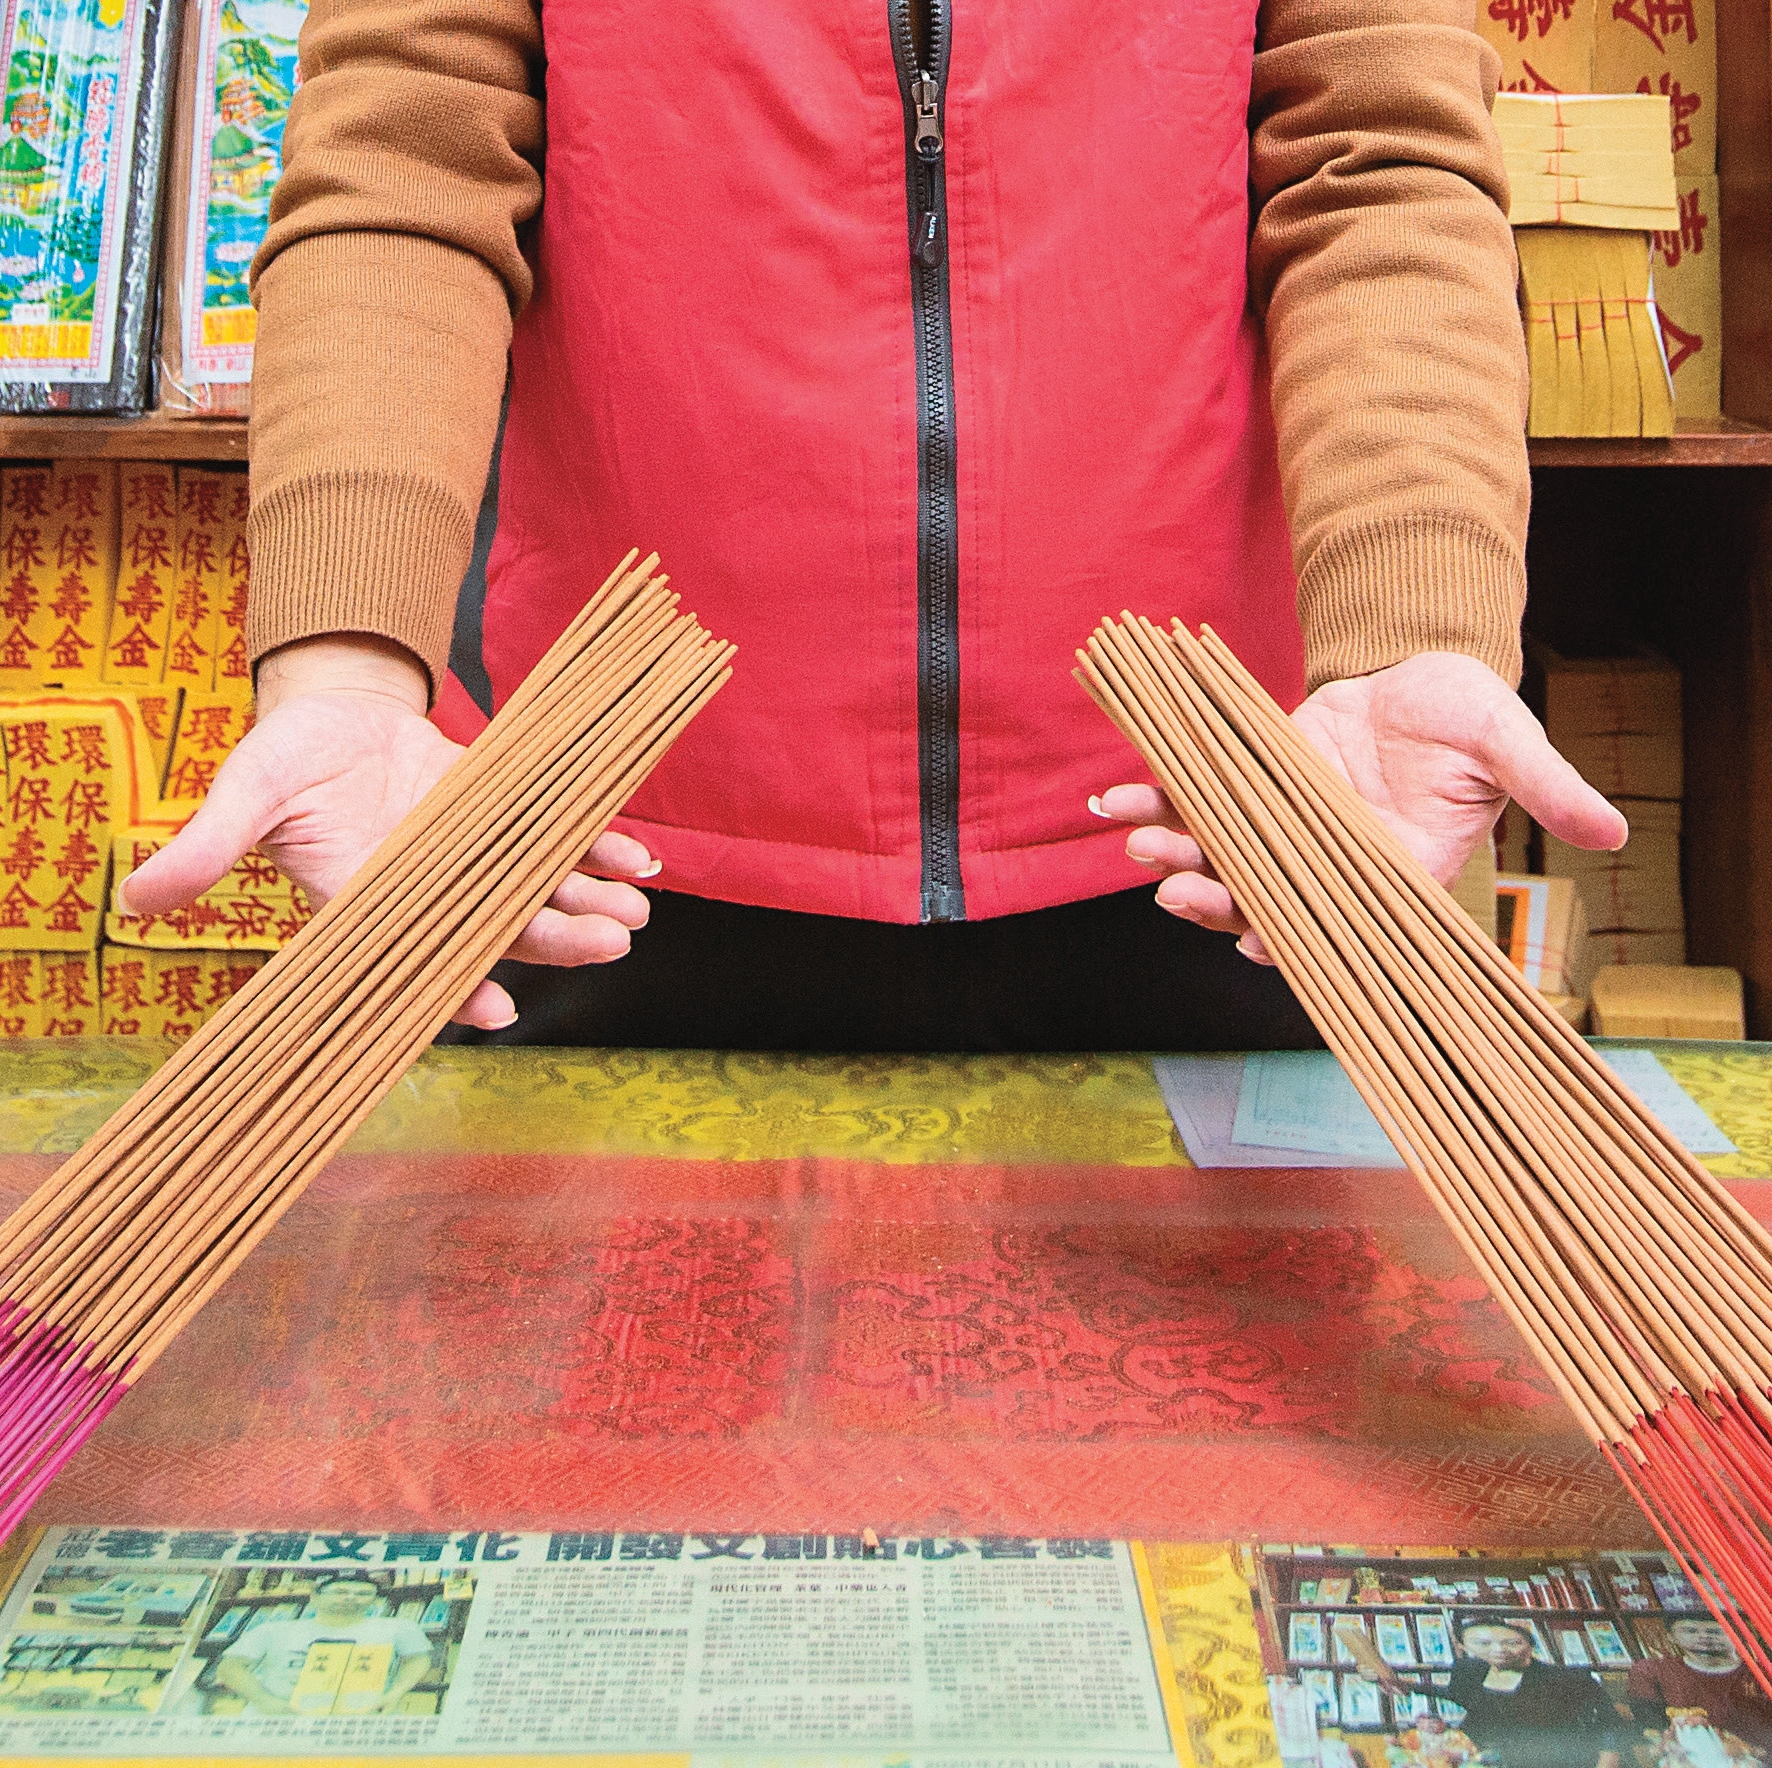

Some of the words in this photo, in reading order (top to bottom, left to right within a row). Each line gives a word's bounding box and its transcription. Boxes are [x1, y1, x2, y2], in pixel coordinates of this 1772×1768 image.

[0, 472, 46, 671] 環保壽金
[47, 473, 114, 670] 環保壽金
[110, 472, 176, 669] 環保壽金
[170, 478, 222, 677] 環保壽金
[43, 723, 113, 935] 環保壽金
